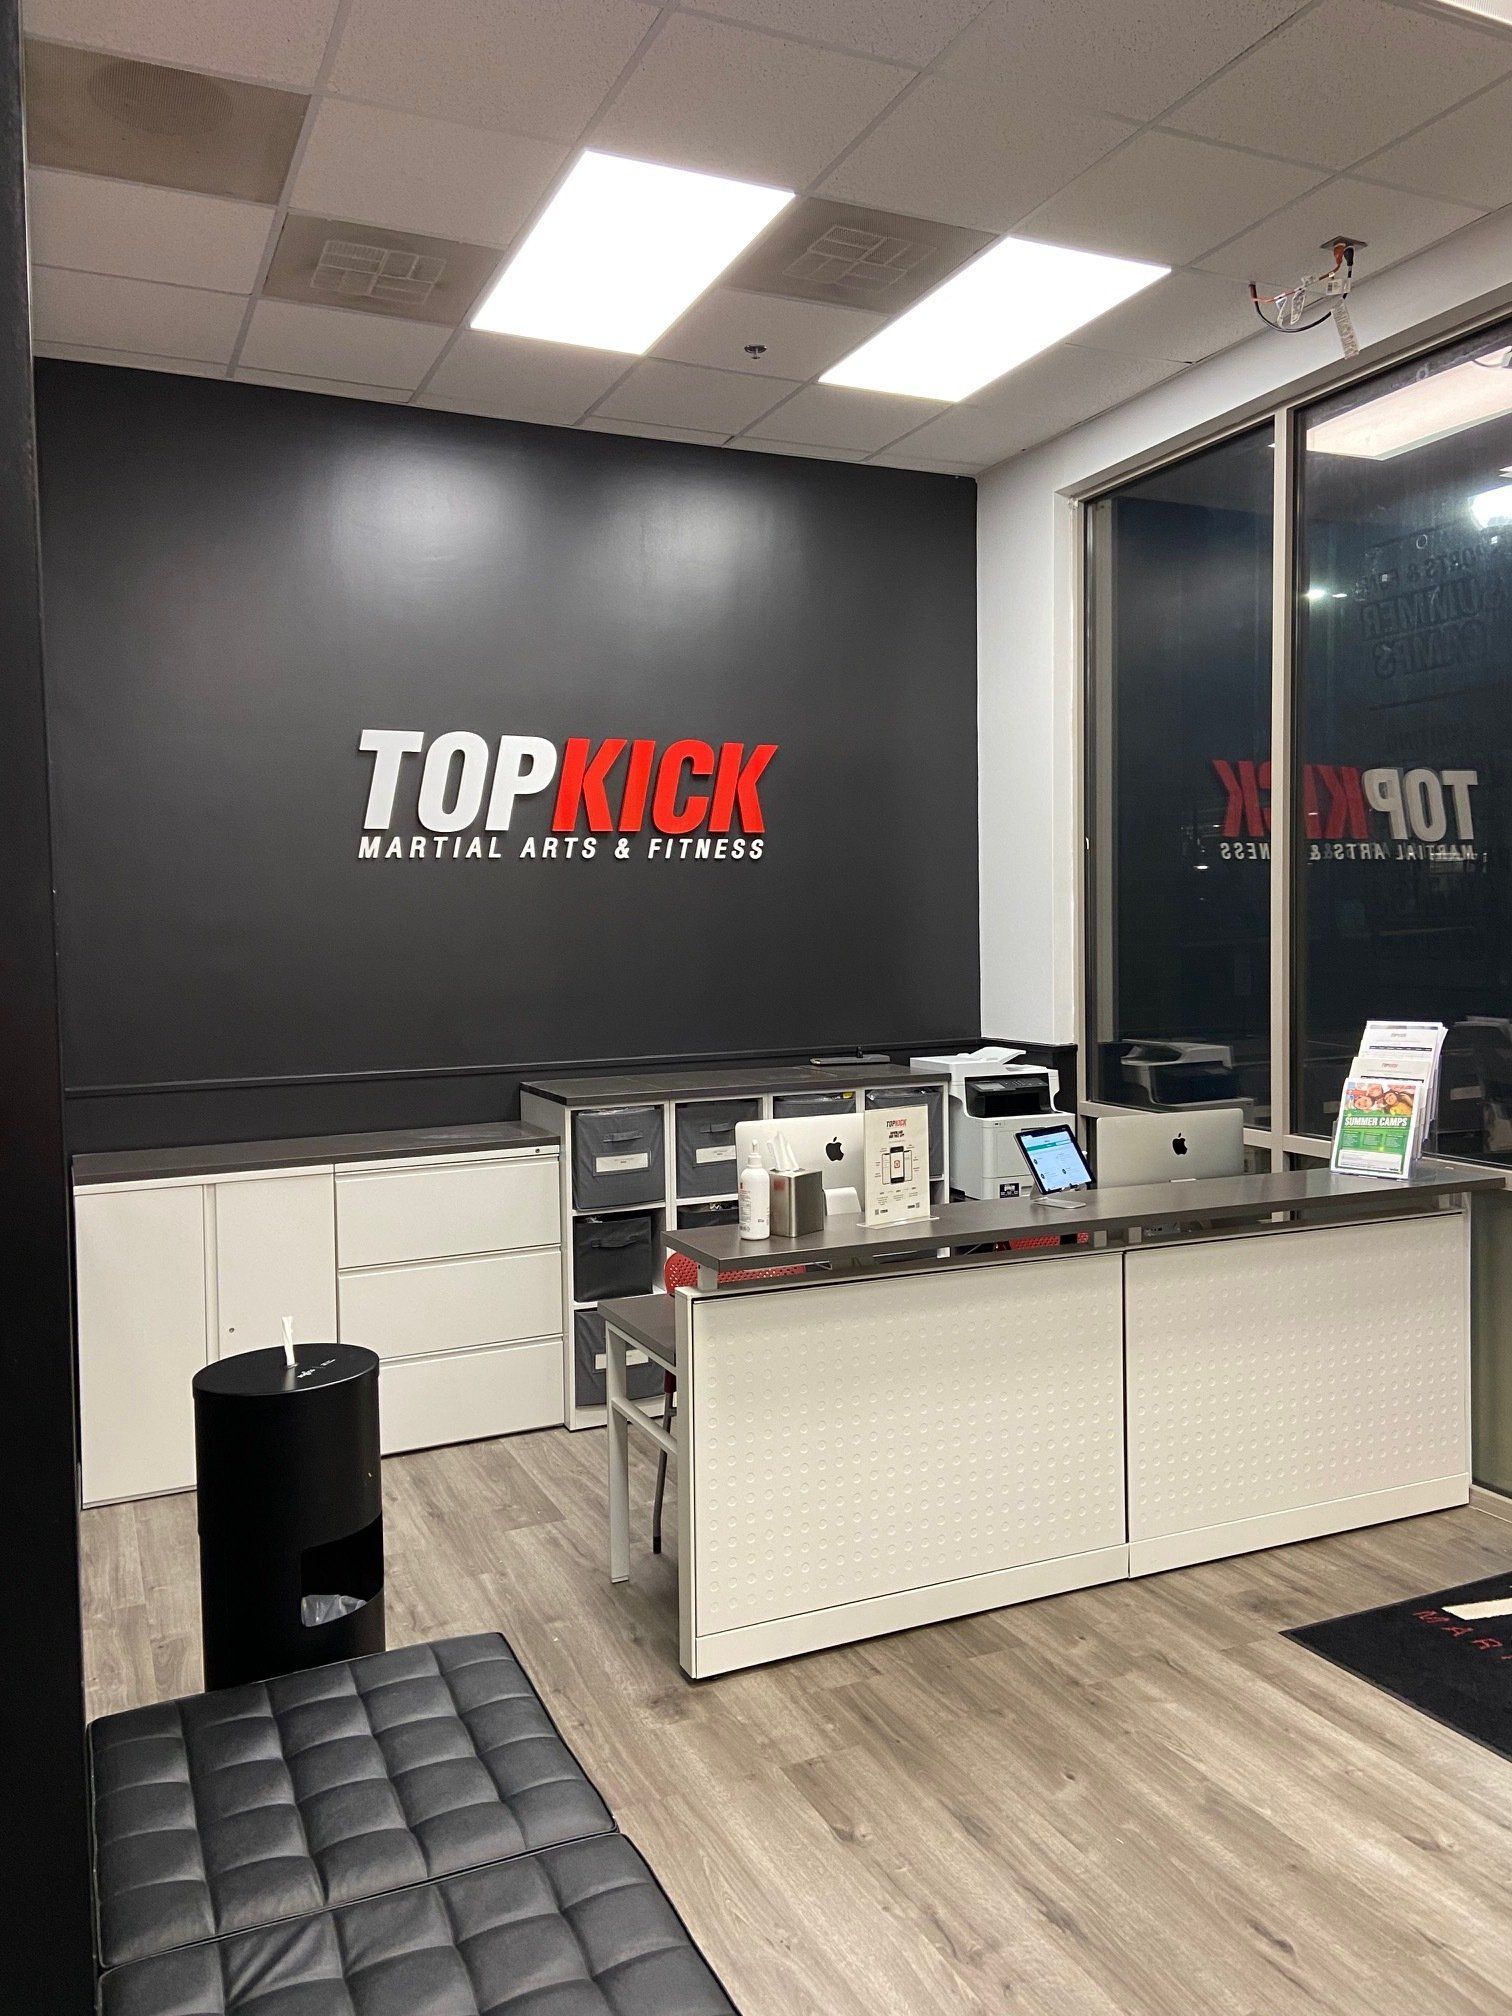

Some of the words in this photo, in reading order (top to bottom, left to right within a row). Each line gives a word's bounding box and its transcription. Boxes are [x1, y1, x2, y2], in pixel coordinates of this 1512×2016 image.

[358, 729, 779, 834] TOPKICK
[358, 836, 502, 859] MARTIAL
[520, 837, 597, 859] ARTS
[614, 837, 630, 860] &
[648, 838, 765, 860] FITNESS
[1344, 1117, 1378, 1127] SUMMER
[1379, 1117, 1408, 1127] CAMPS
